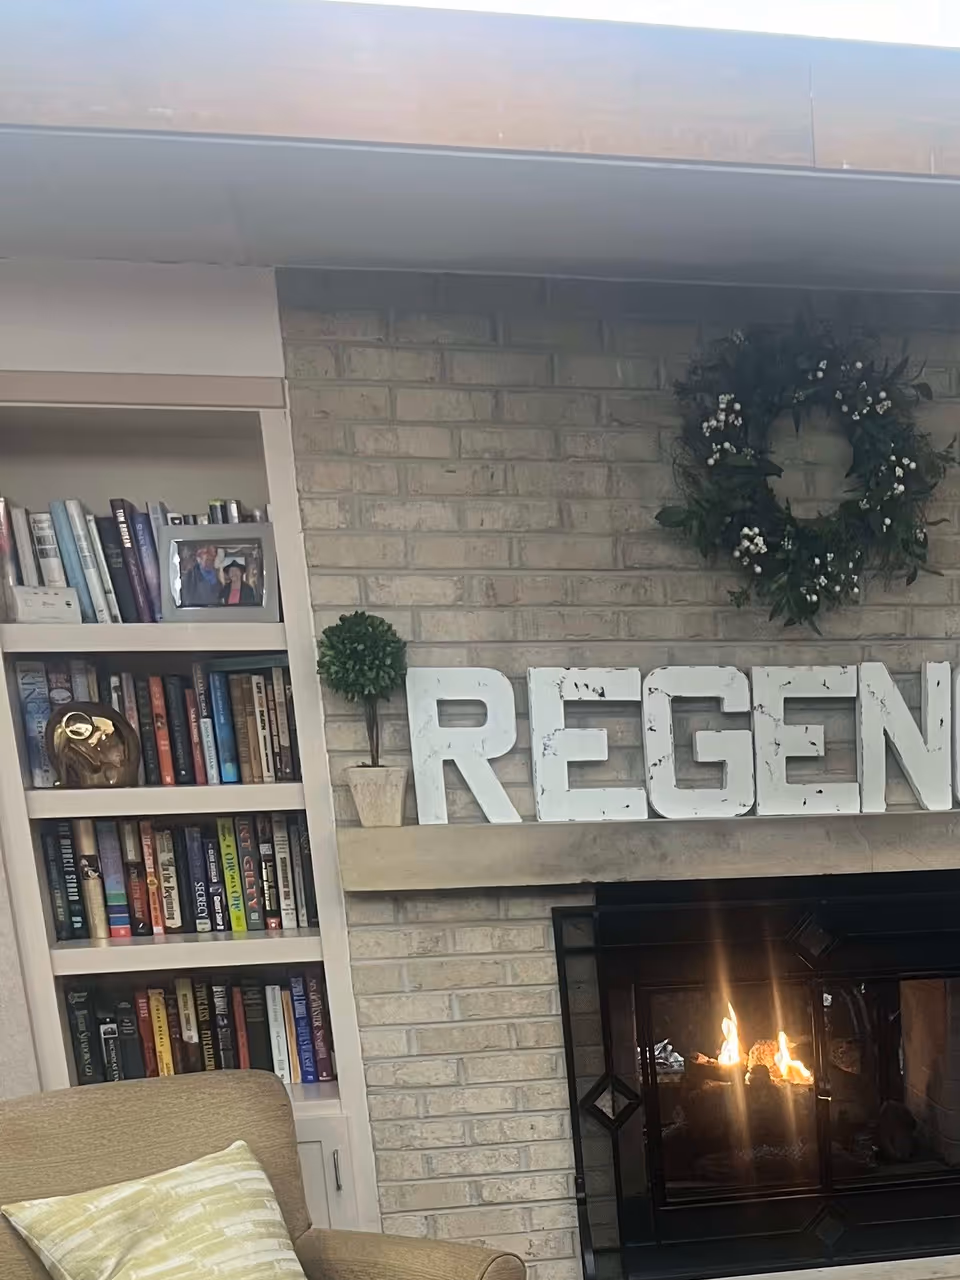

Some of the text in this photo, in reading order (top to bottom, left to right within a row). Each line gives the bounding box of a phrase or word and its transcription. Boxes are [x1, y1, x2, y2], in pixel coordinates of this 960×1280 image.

[116, 509, 126, 522] TOM
[60, 839, 75, 872] MIRACLE
[164, 873, 172, 884] the
[164, 886, 176, 920] Beginning
[194, 882, 208, 918] SECRECY
